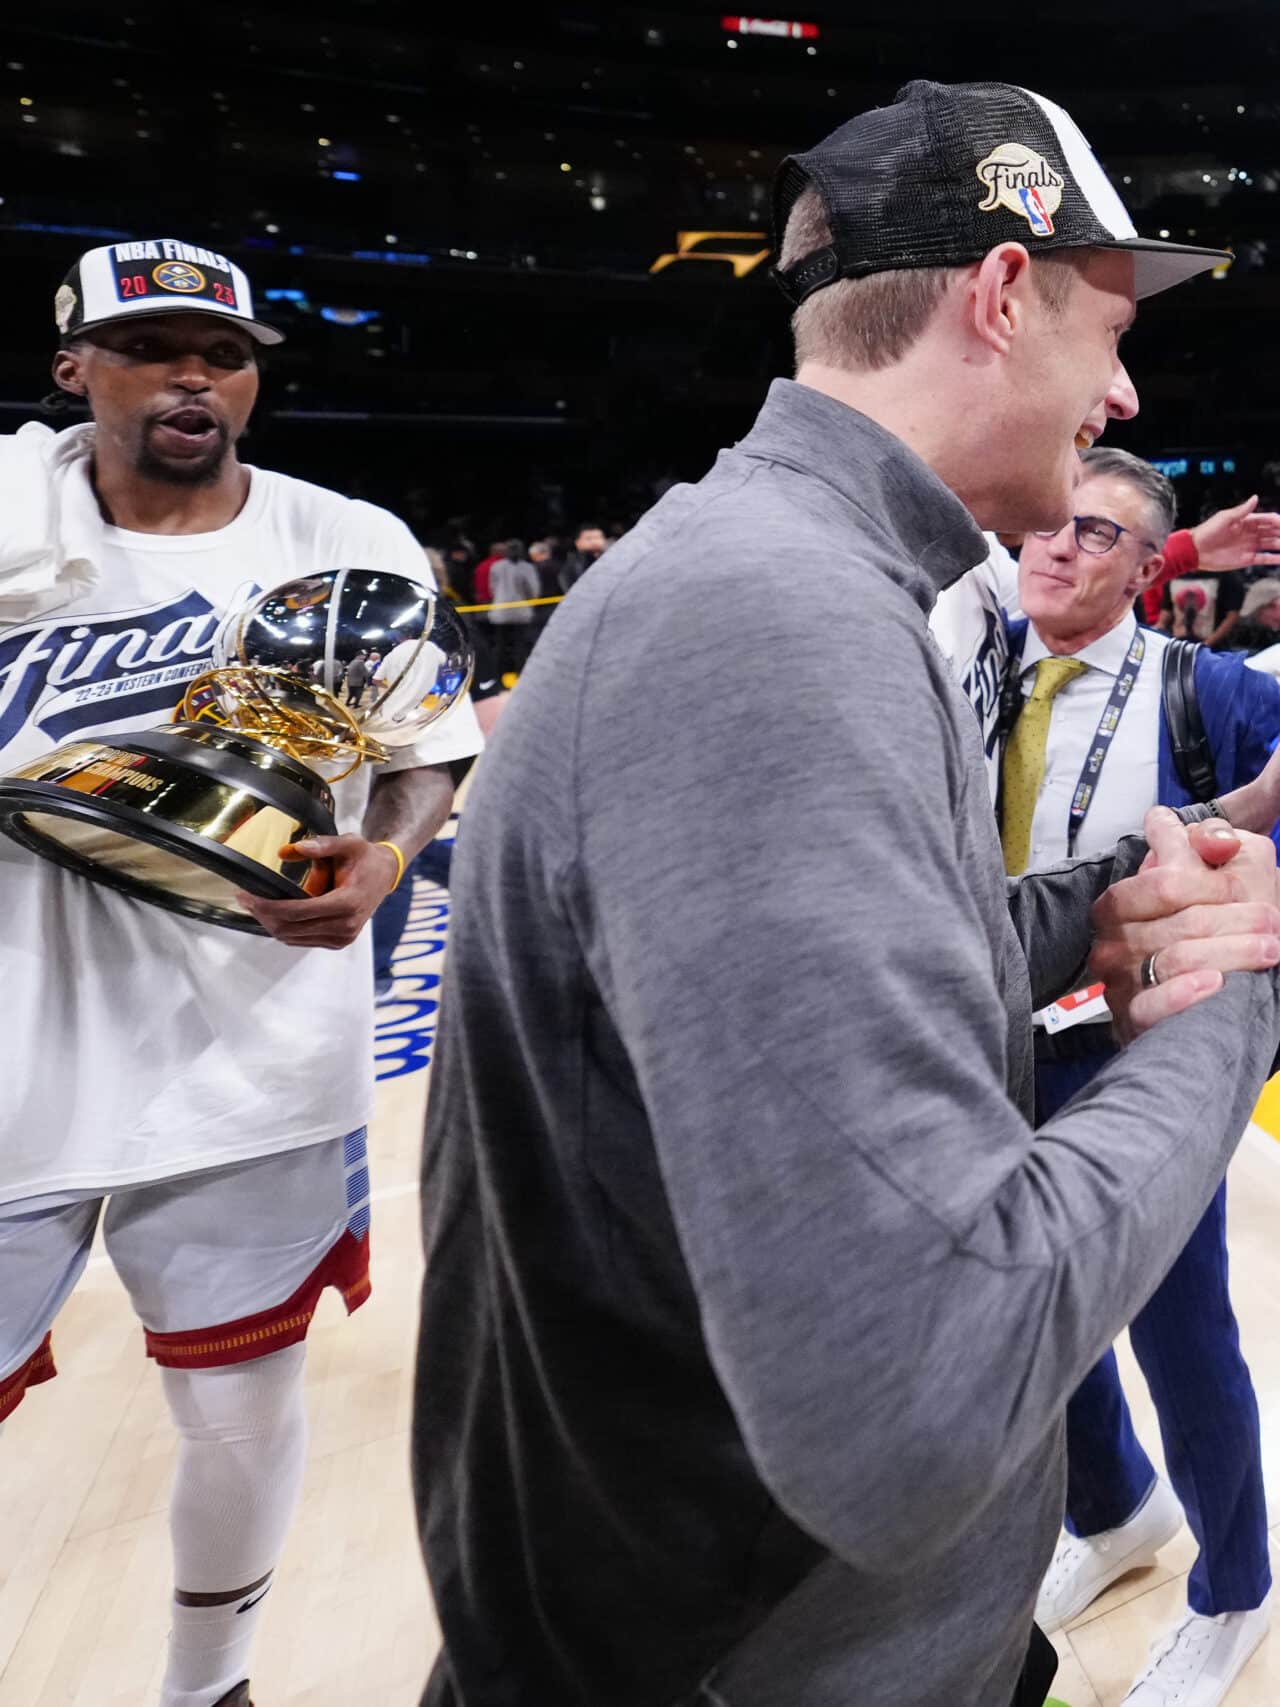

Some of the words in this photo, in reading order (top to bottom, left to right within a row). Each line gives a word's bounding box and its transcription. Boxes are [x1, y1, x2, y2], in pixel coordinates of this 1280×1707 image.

[981, 159, 1061, 209] Finals
[114, 241, 161, 263] NBA
[161, 239, 231, 274] FINALS
[120, 275, 147, 298] 20
[213, 282, 236, 306] 23
[0, 584, 257, 722] Fina
[115, 672, 163, 692] WESTERN
[164, 661, 212, 682] CONFER
